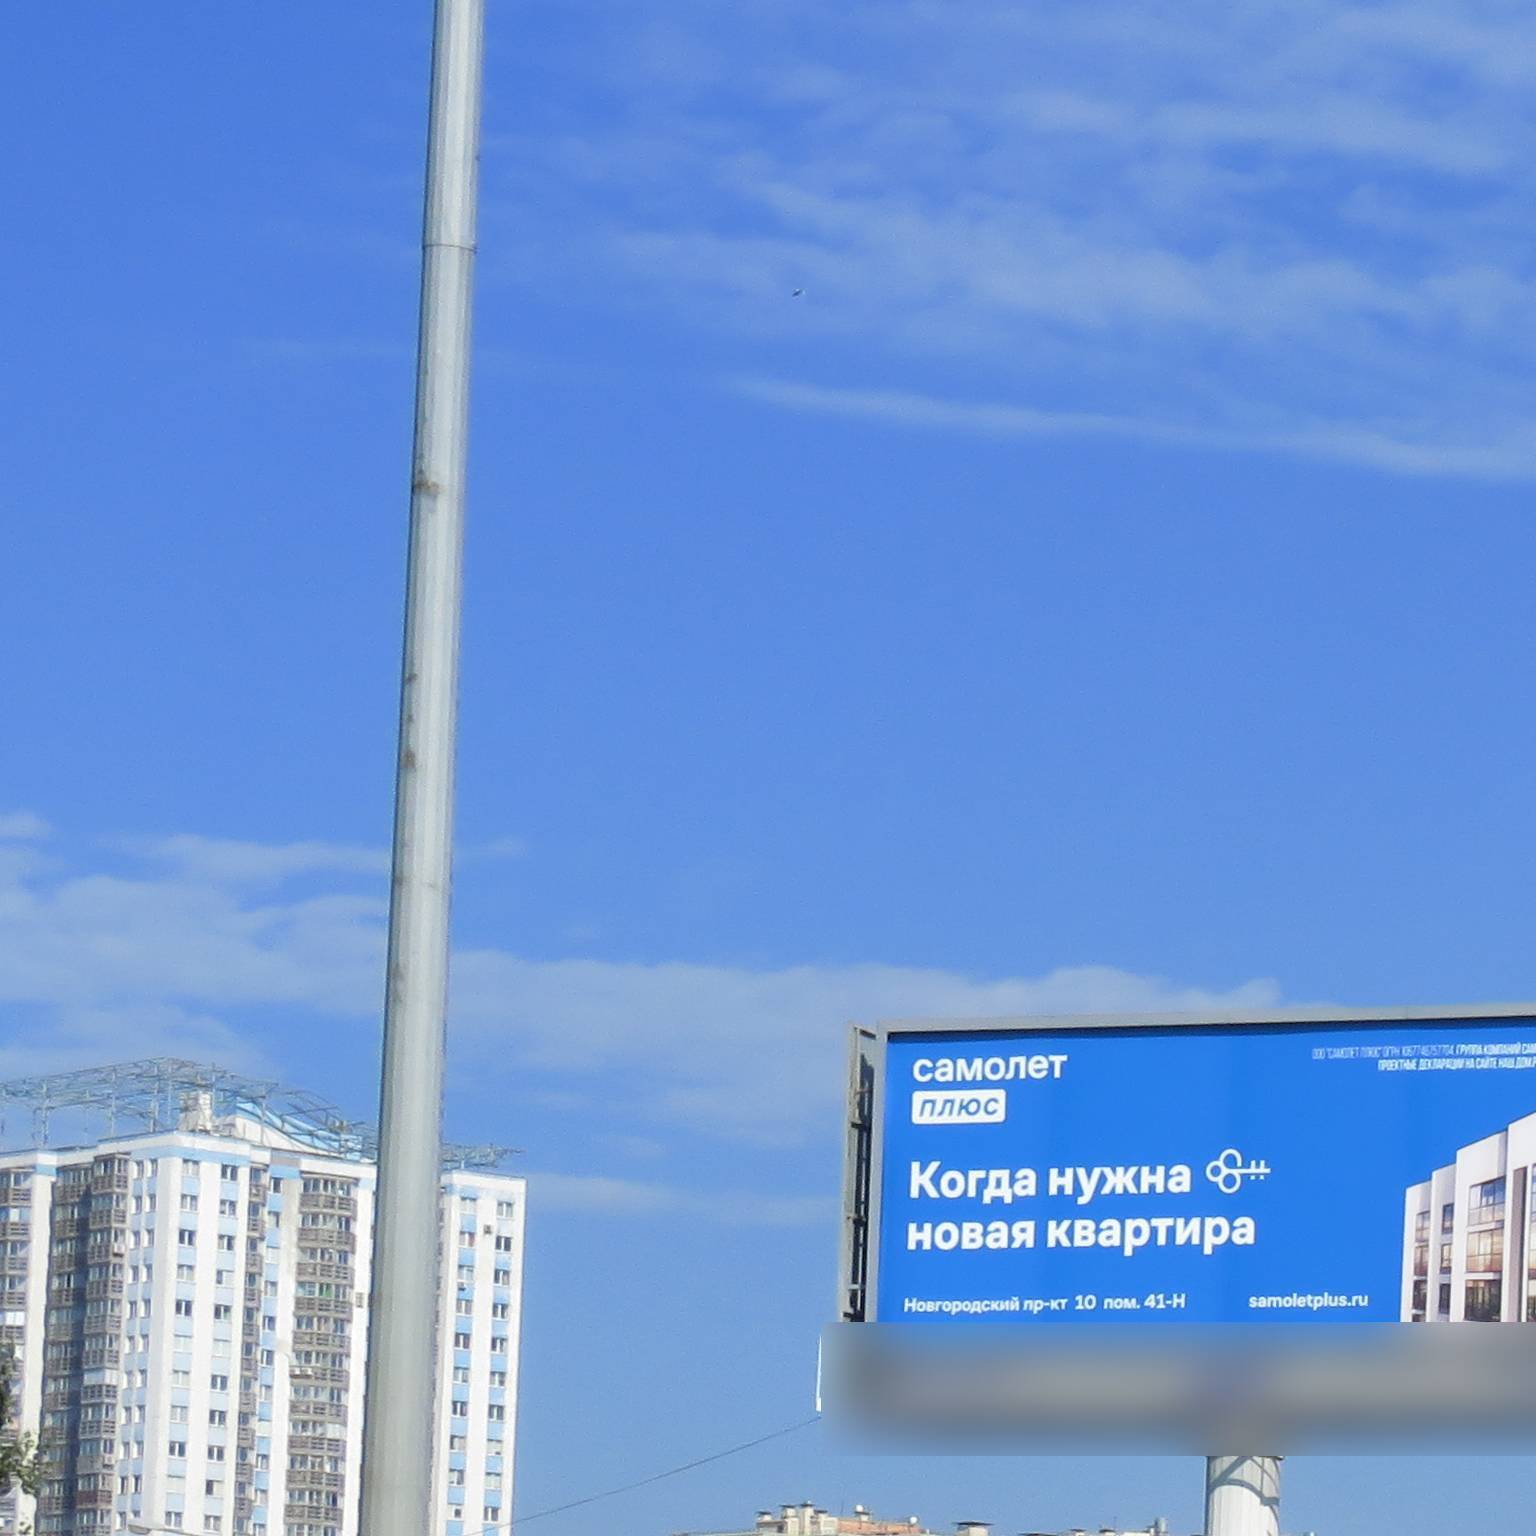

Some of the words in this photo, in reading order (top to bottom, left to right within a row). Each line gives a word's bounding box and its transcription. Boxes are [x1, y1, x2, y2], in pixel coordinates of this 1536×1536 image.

[912, 1054, 1068, 1082] самолет
[918, 1096, 1000, 1118] плюс
[909, 1159, 1037, 1204] Когда
[1048, 1163, 1192, 1205] нужна
[906, 1219, 1036, 1251] новая
[1046, 1214, 1256, 1257] квартира
[903, 1296, 1020, 1316] Новгородский
[1023, 1297, 1069, 1315] пр-кт
[1074, 1294, 1097, 1310] 10
[1103, 1296, 1140, 1310] пом.
[1144, 1292, 1186, 1309] 41-Н
[1248, 1291, 1369, 1312] samoletplus.ru
